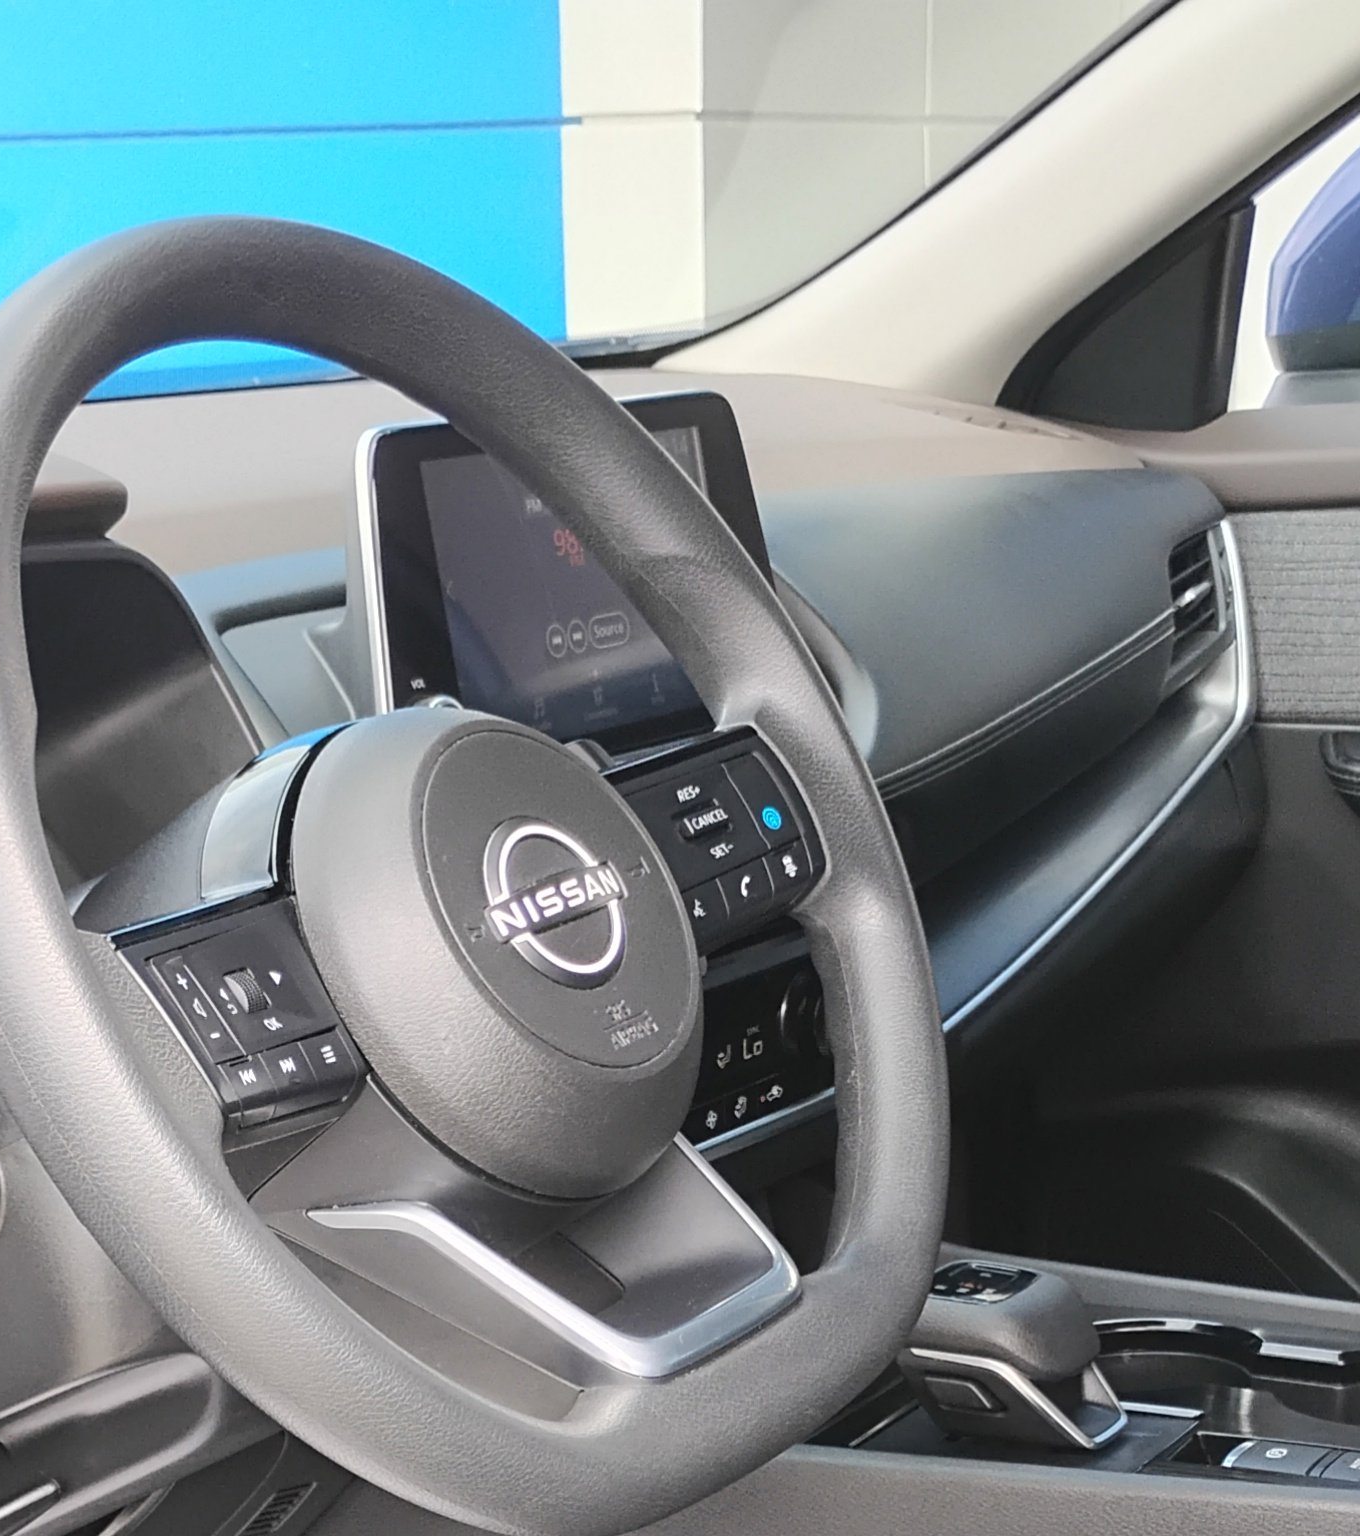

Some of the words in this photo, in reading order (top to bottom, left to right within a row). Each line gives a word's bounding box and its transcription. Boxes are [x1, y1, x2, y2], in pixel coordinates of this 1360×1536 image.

[592, 622, 625, 639] Source
[410, 677, 426, 690] VOL
[691, 808, 729, 830] CANCEL
[490, 867, 621, 938] NISSAN
[262, 1016, 284, 1032] OK
[610, 1017, 659, 1050] AIRBAG
